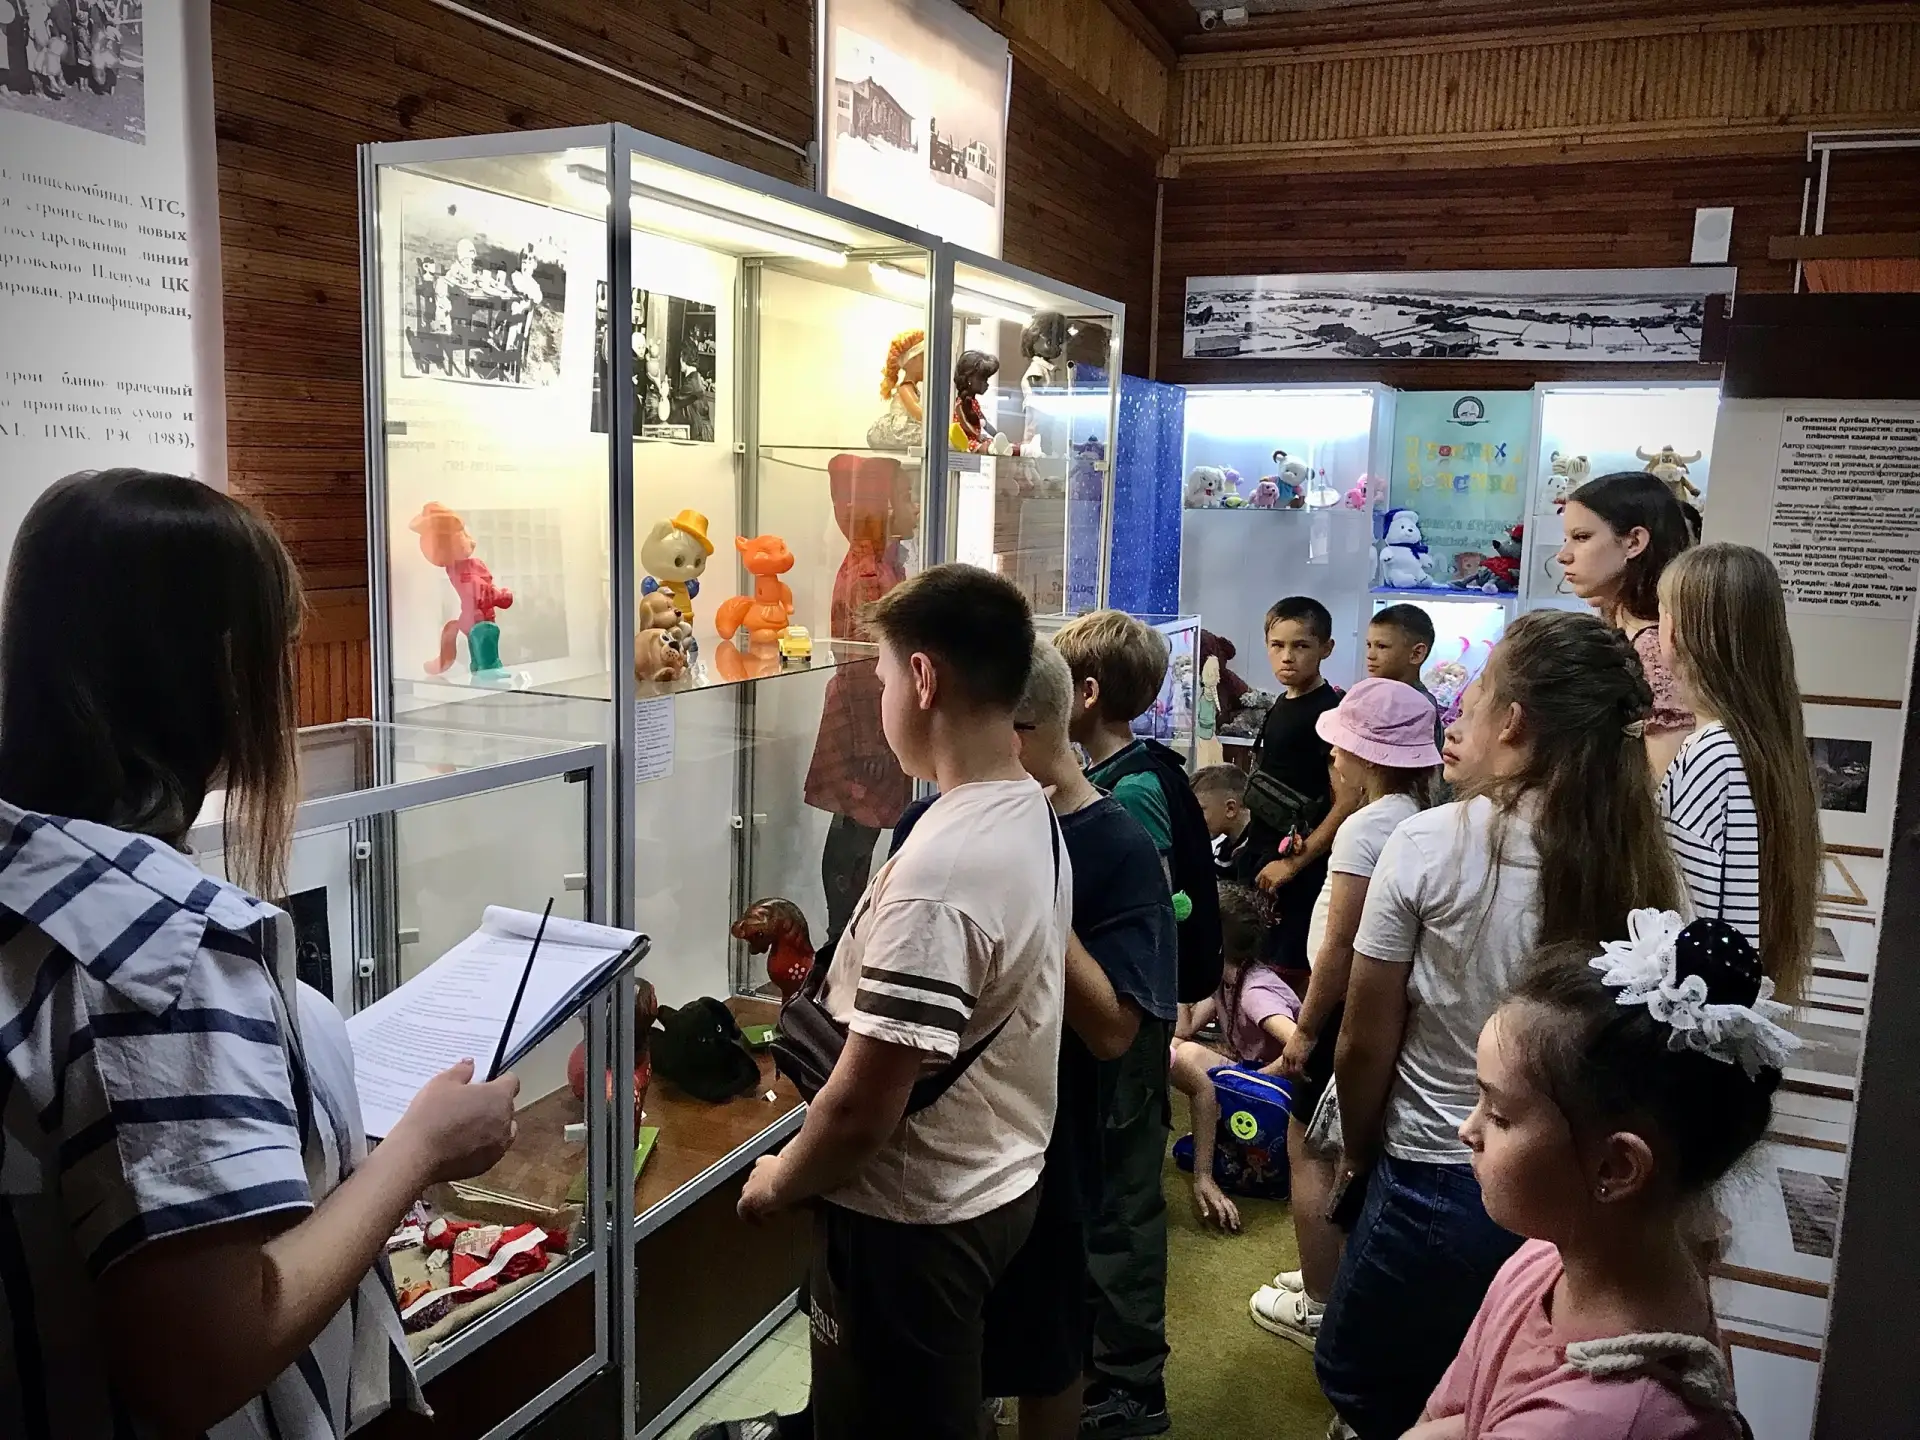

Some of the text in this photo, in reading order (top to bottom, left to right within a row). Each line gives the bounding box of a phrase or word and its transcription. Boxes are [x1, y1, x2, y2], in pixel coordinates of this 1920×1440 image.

[140, 195, 185, 218] МТС,
[138, 224, 187, 241] новых
[140, 251, 189, 267] линии
[162, 276, 189, 293] ЦК
[117, 381, 193, 397] прачечный
[183, 412, 193, 421] и
[1794, 415, 1837, 424] объективе
[148, 430, 194, 449] (1983),
[1851, 434, 1881, 442] камера
[1782, 441, 1805, 451] Автор
[1803, 544, 1836, 553] прогулка
[1793, 567, 1825, 577] угостить
